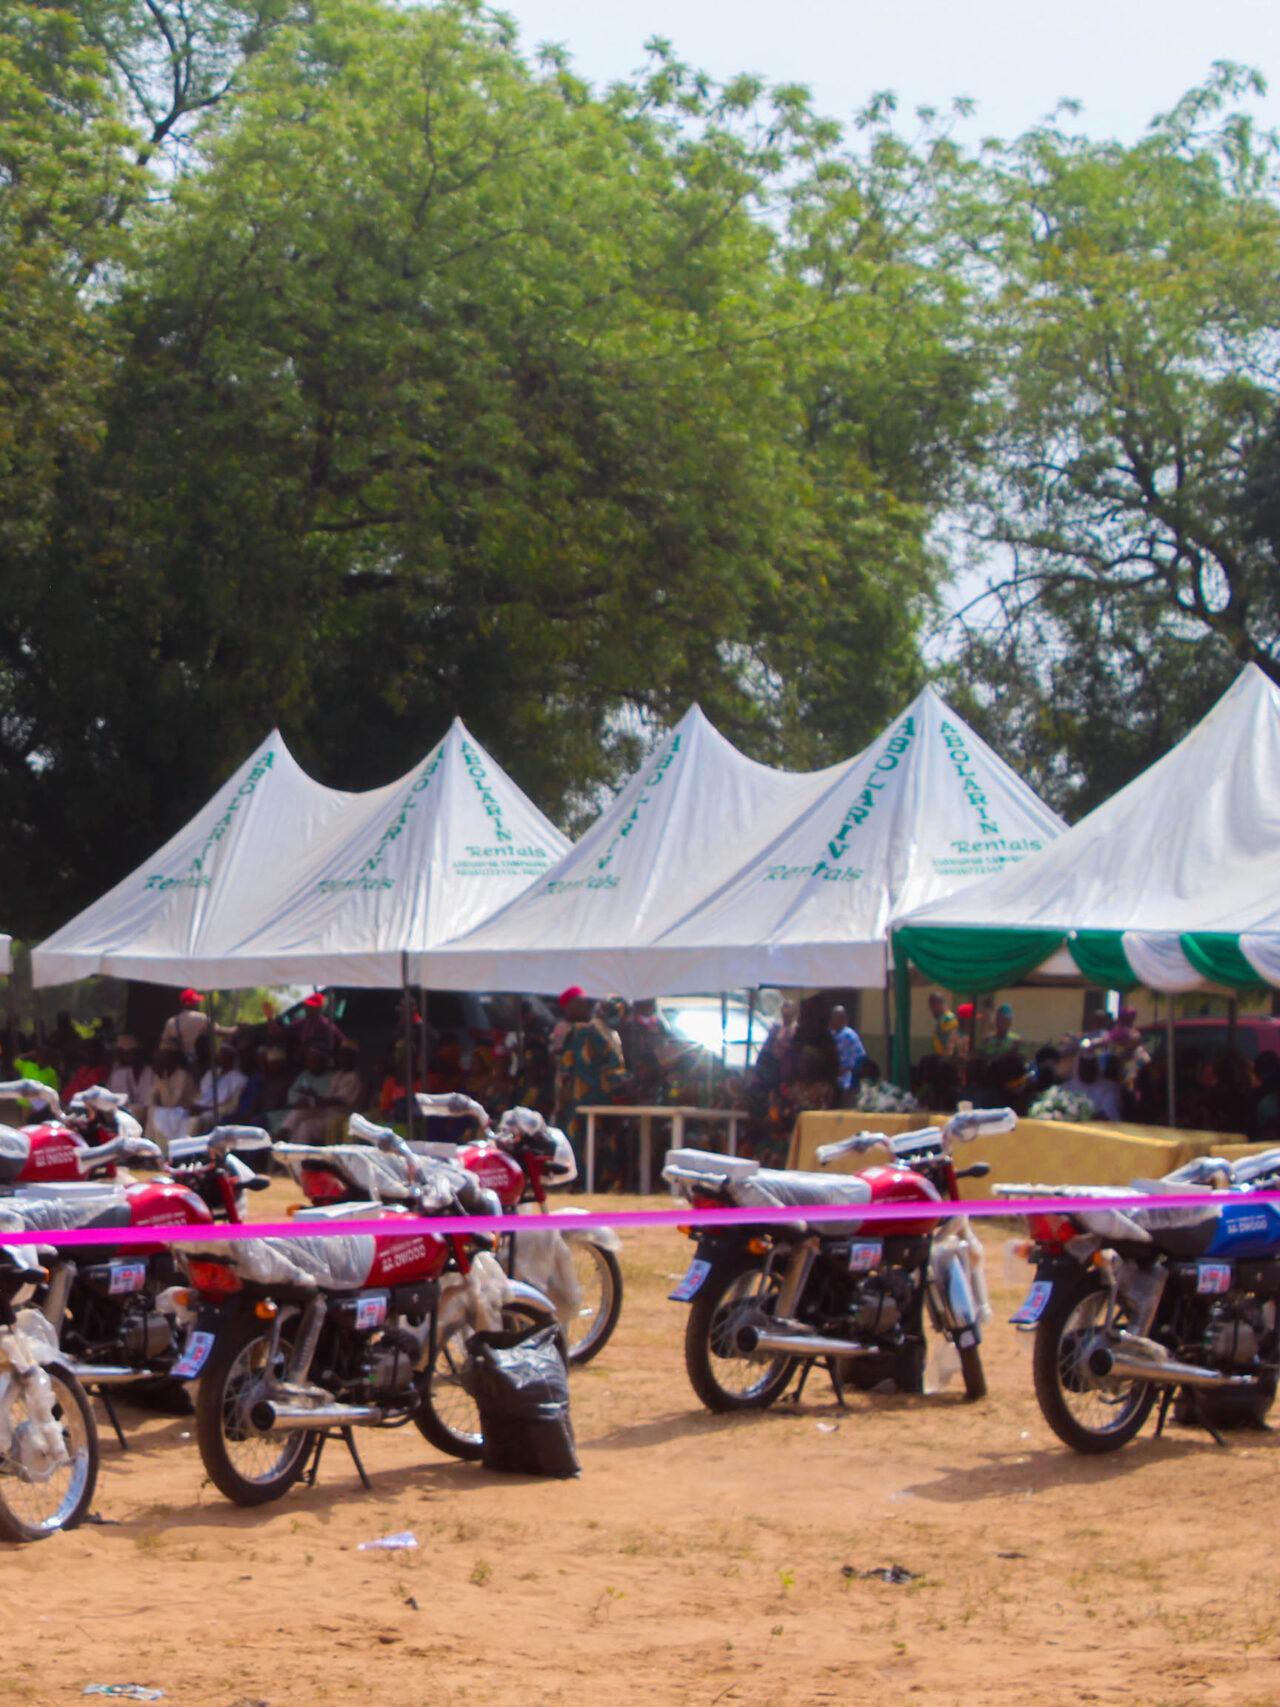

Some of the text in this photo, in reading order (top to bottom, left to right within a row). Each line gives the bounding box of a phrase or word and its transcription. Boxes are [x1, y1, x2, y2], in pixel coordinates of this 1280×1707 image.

[461, 741, 512, 842] ABOLARIN
[940, 721, 1000, 835] ABOLARIN
[465, 845, 547, 857] Rentals
[951, 838, 1044, 853] Rentals
